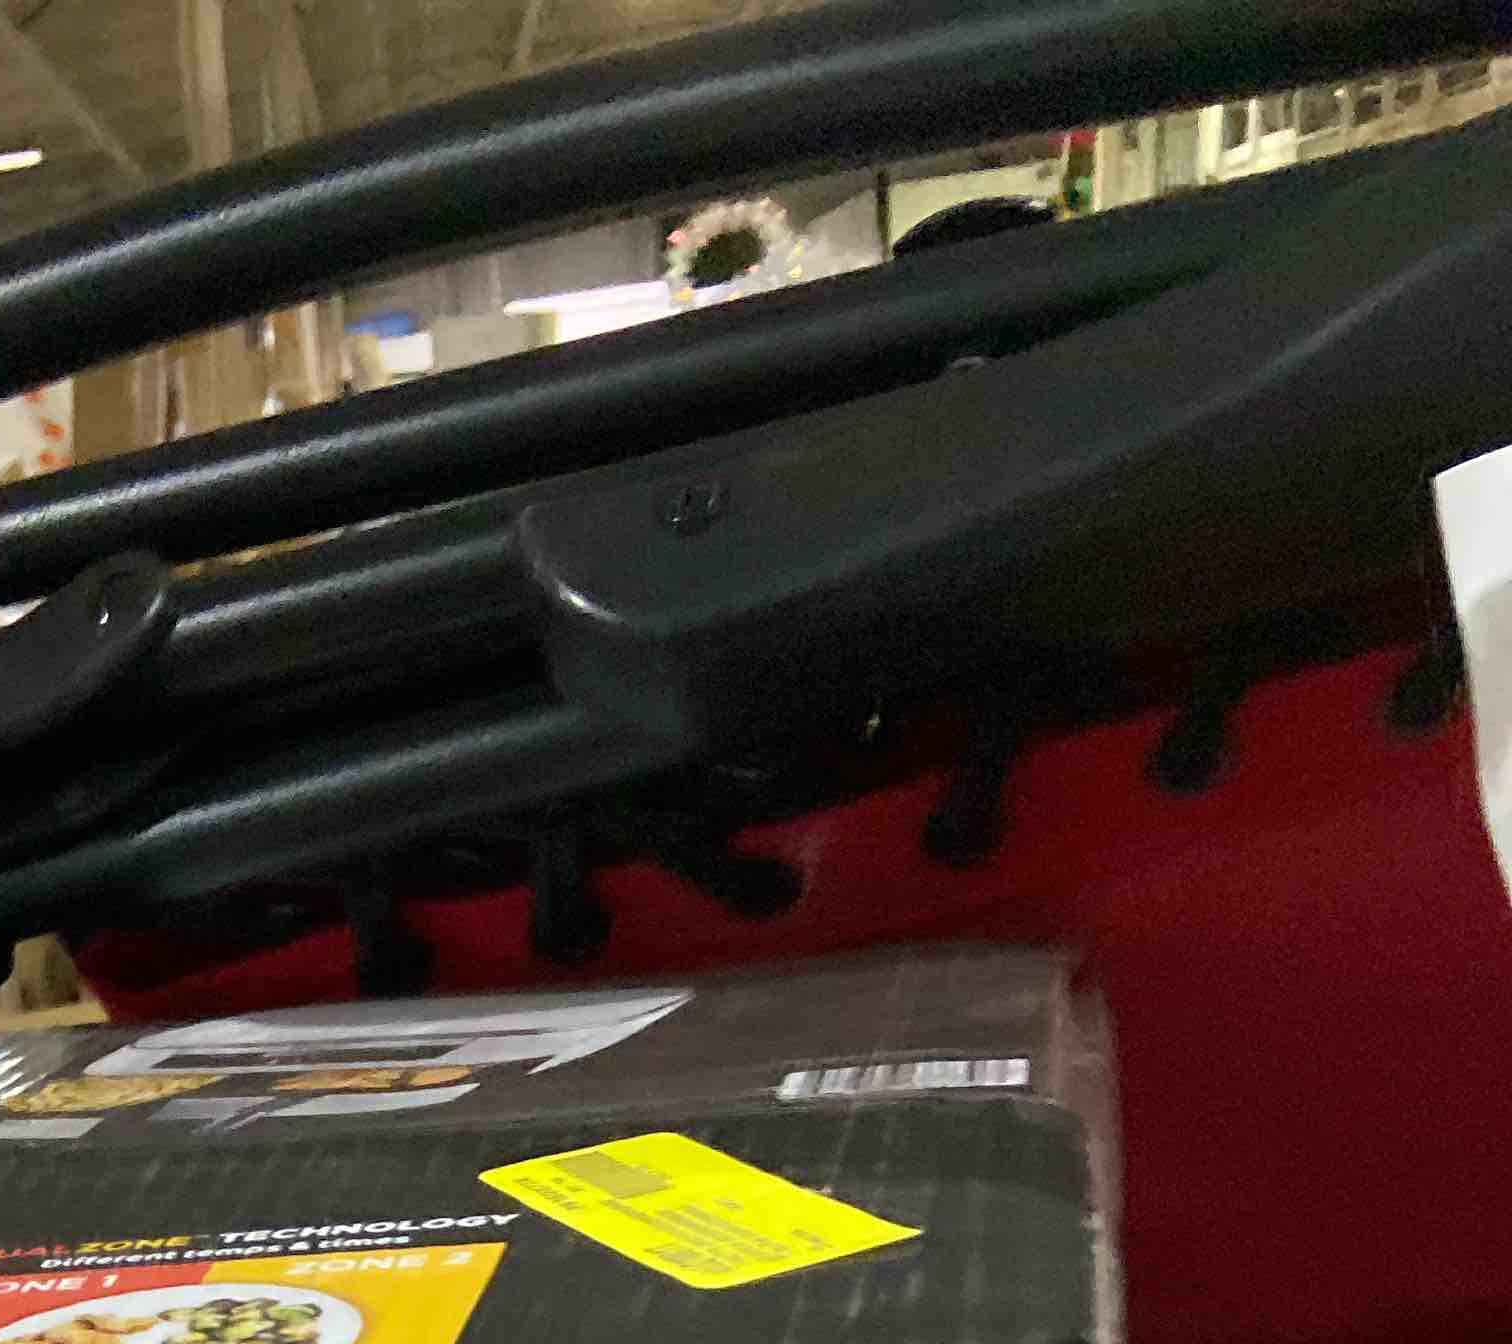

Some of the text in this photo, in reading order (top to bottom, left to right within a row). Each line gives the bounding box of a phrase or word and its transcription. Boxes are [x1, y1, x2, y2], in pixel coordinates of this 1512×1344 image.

[218, 1213, 522, 1245] TECHNOLOGY
[285, 1251, 473, 1275] ZONE 2
[102, 1274, 120, 1288] 1
